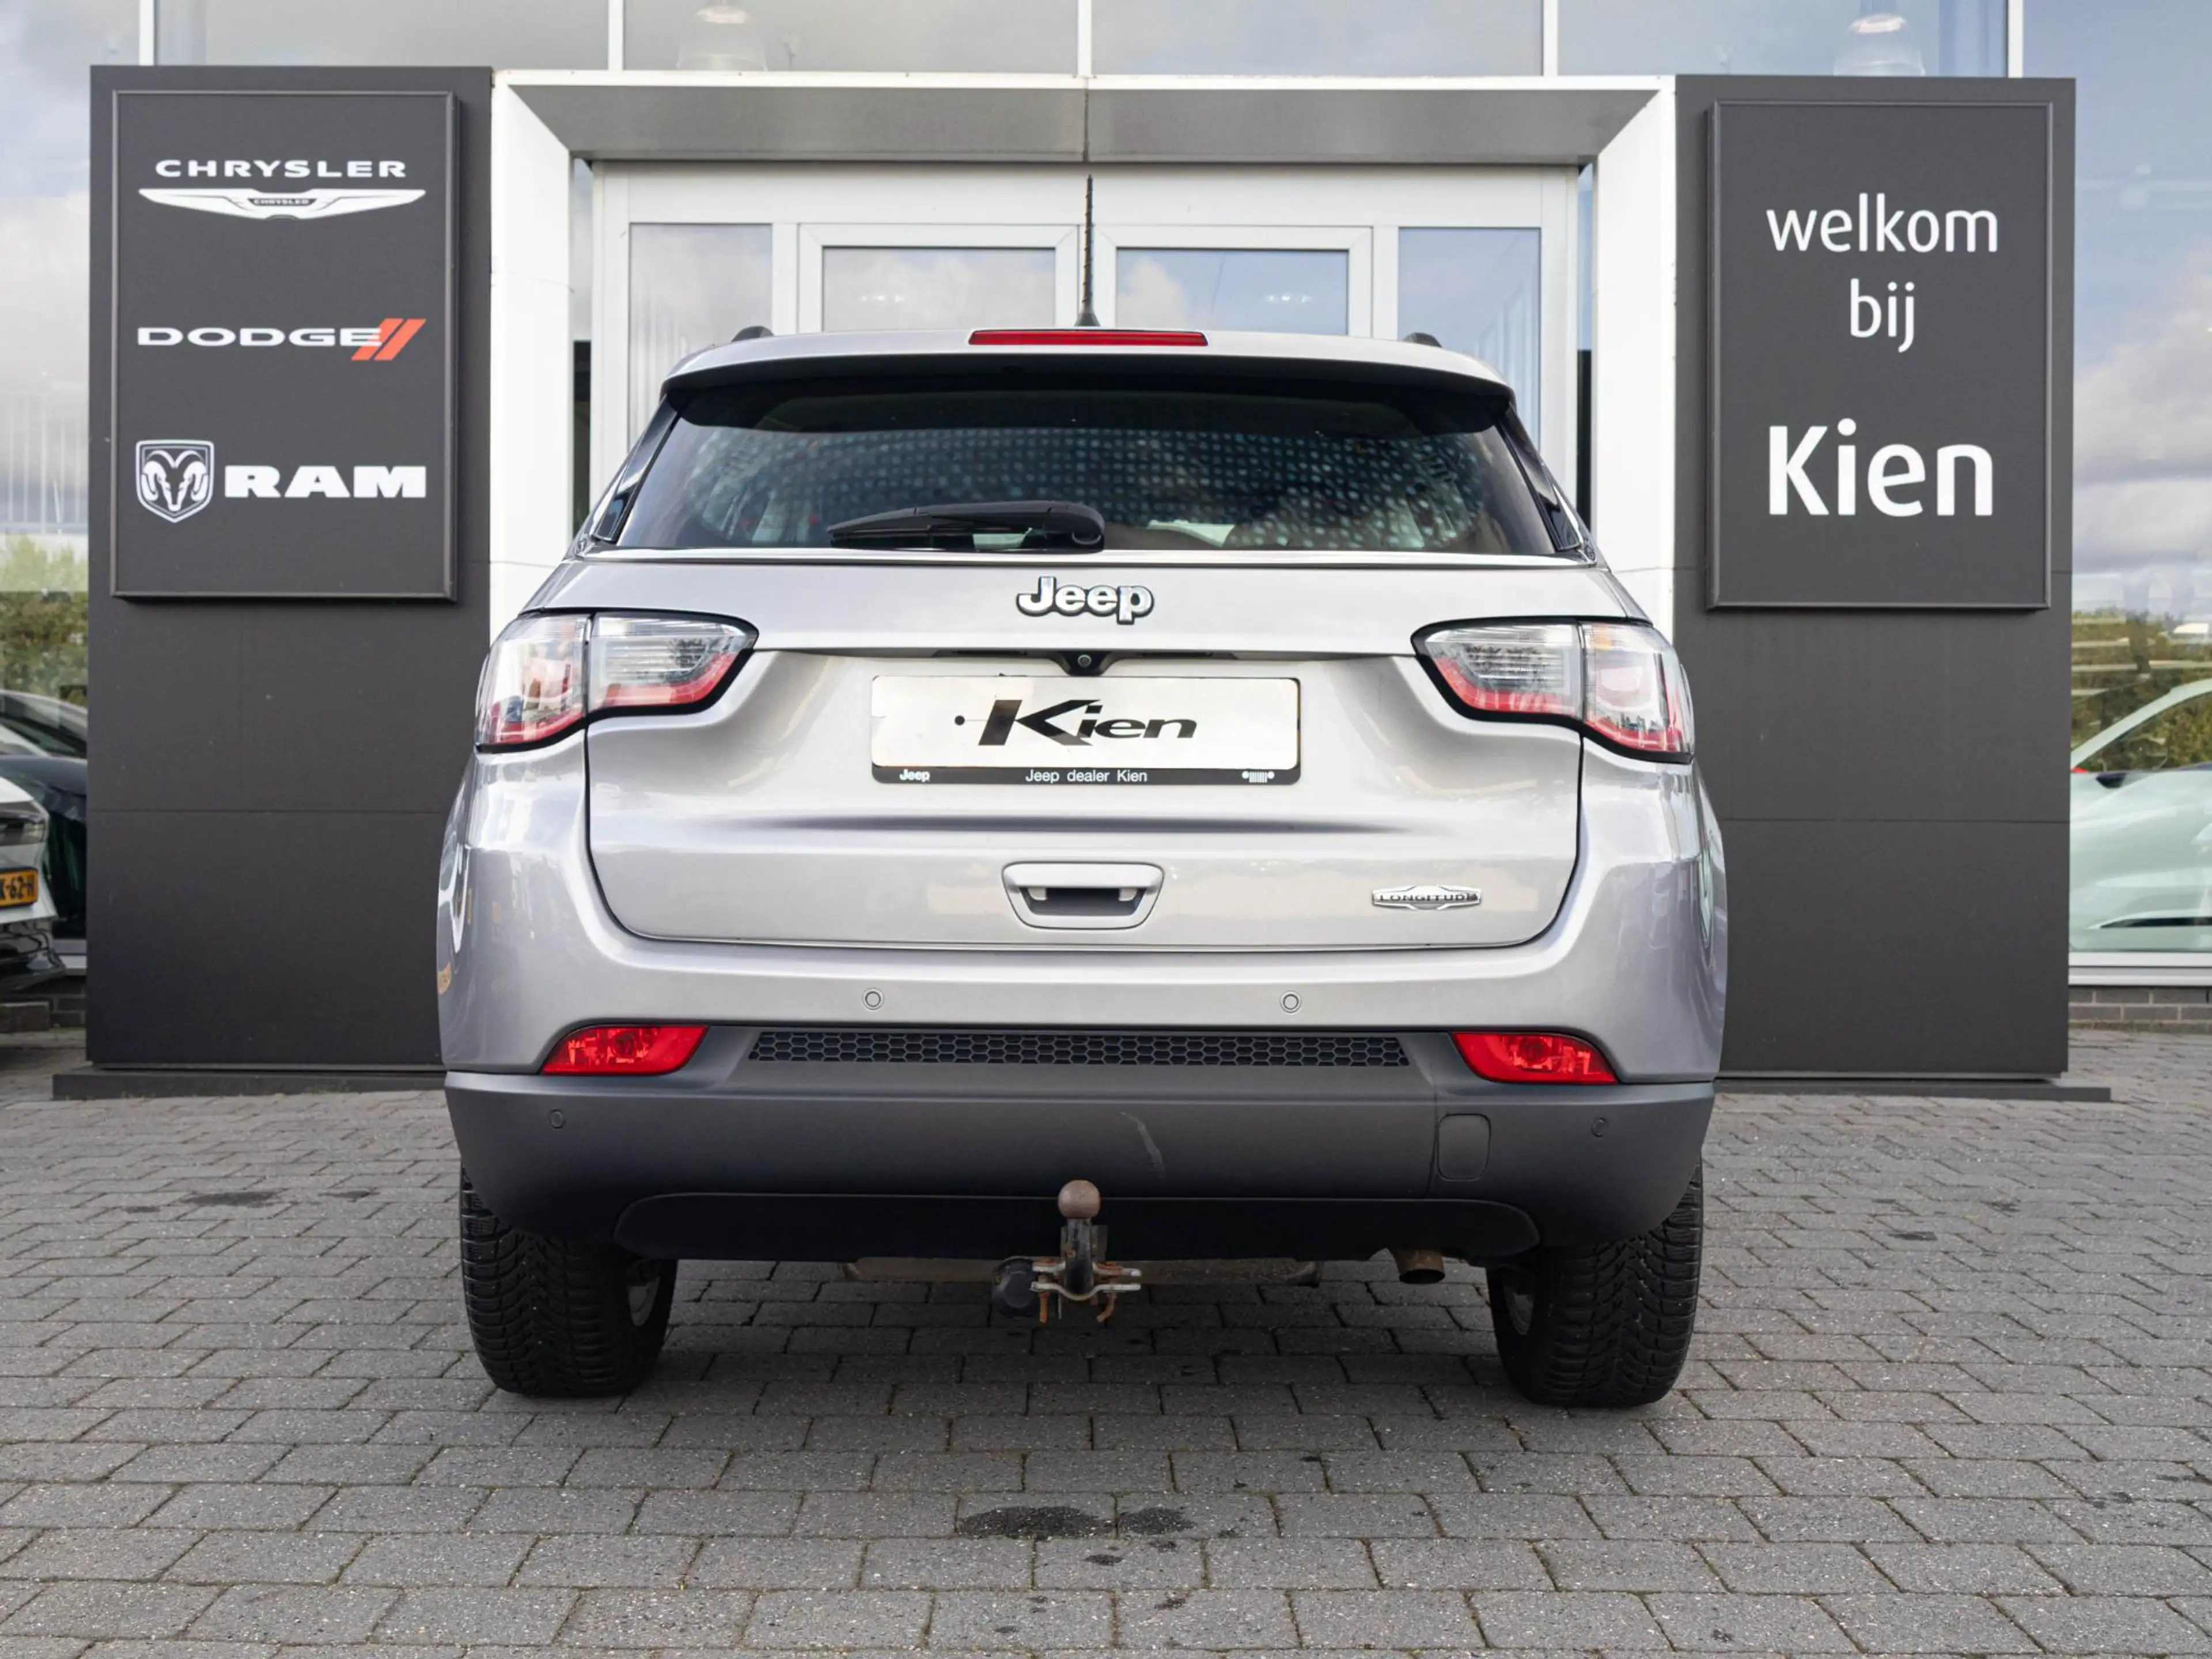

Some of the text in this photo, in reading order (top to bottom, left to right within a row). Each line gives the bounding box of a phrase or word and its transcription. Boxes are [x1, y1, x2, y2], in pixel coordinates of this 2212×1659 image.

[156, 159, 406, 178] CHRYSLER
[1766, 193, 1998, 252] welkom
[1850, 278, 1915, 353] bij
[138, 327, 382, 347] DODGE
[225, 465, 426, 498] RAM
[1769, 418, 1993, 517] Kien
[1016, 576, 1154, 625] Jeep
[978, 699, 1198, 747] Kien
[899, 768, 930, 783] Jeep
[1025, 769, 1148, 783] Jeep dealer Kien
